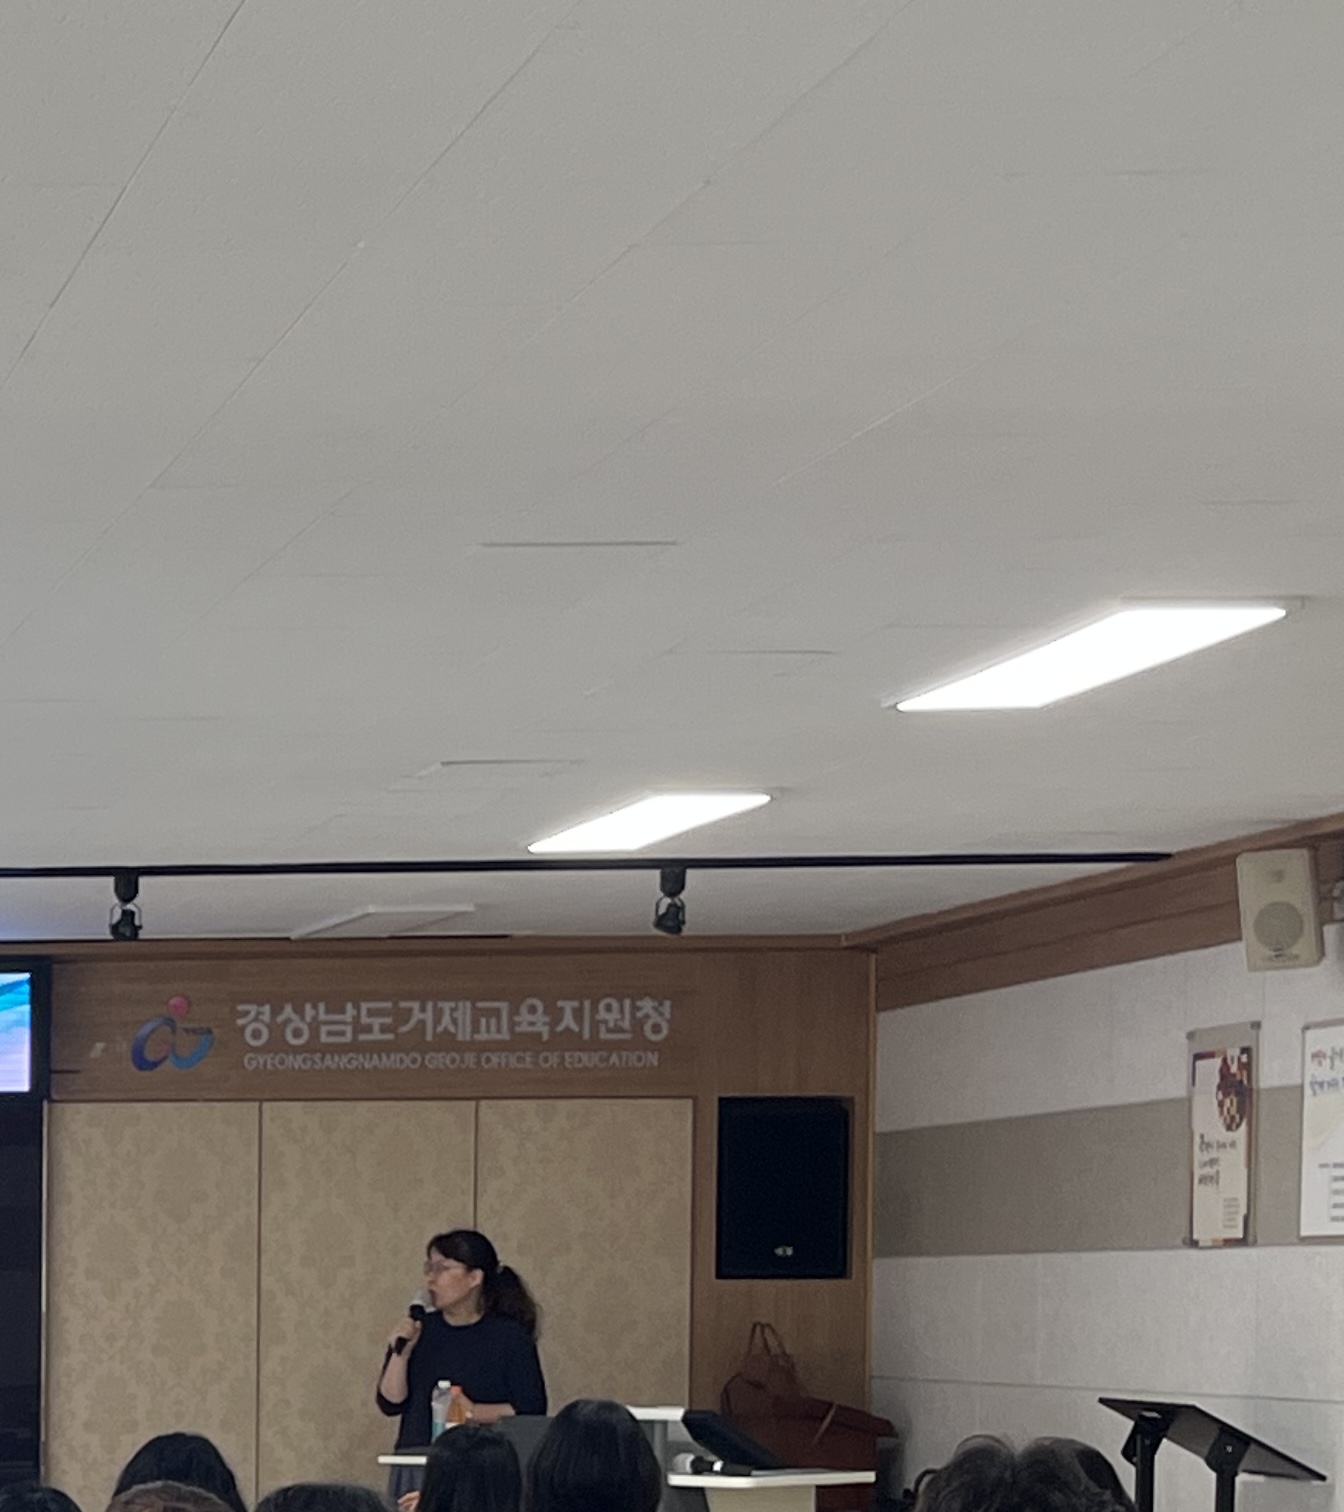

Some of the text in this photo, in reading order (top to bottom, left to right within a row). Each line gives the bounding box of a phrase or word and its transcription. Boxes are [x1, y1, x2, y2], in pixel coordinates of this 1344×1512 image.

[236, 997, 672, 1047] 경상남도거제교육지원청
[244, 1051, 659, 1070] GYEONGSANGNAMDO GEOJE OFFICE OF EDUCATION
